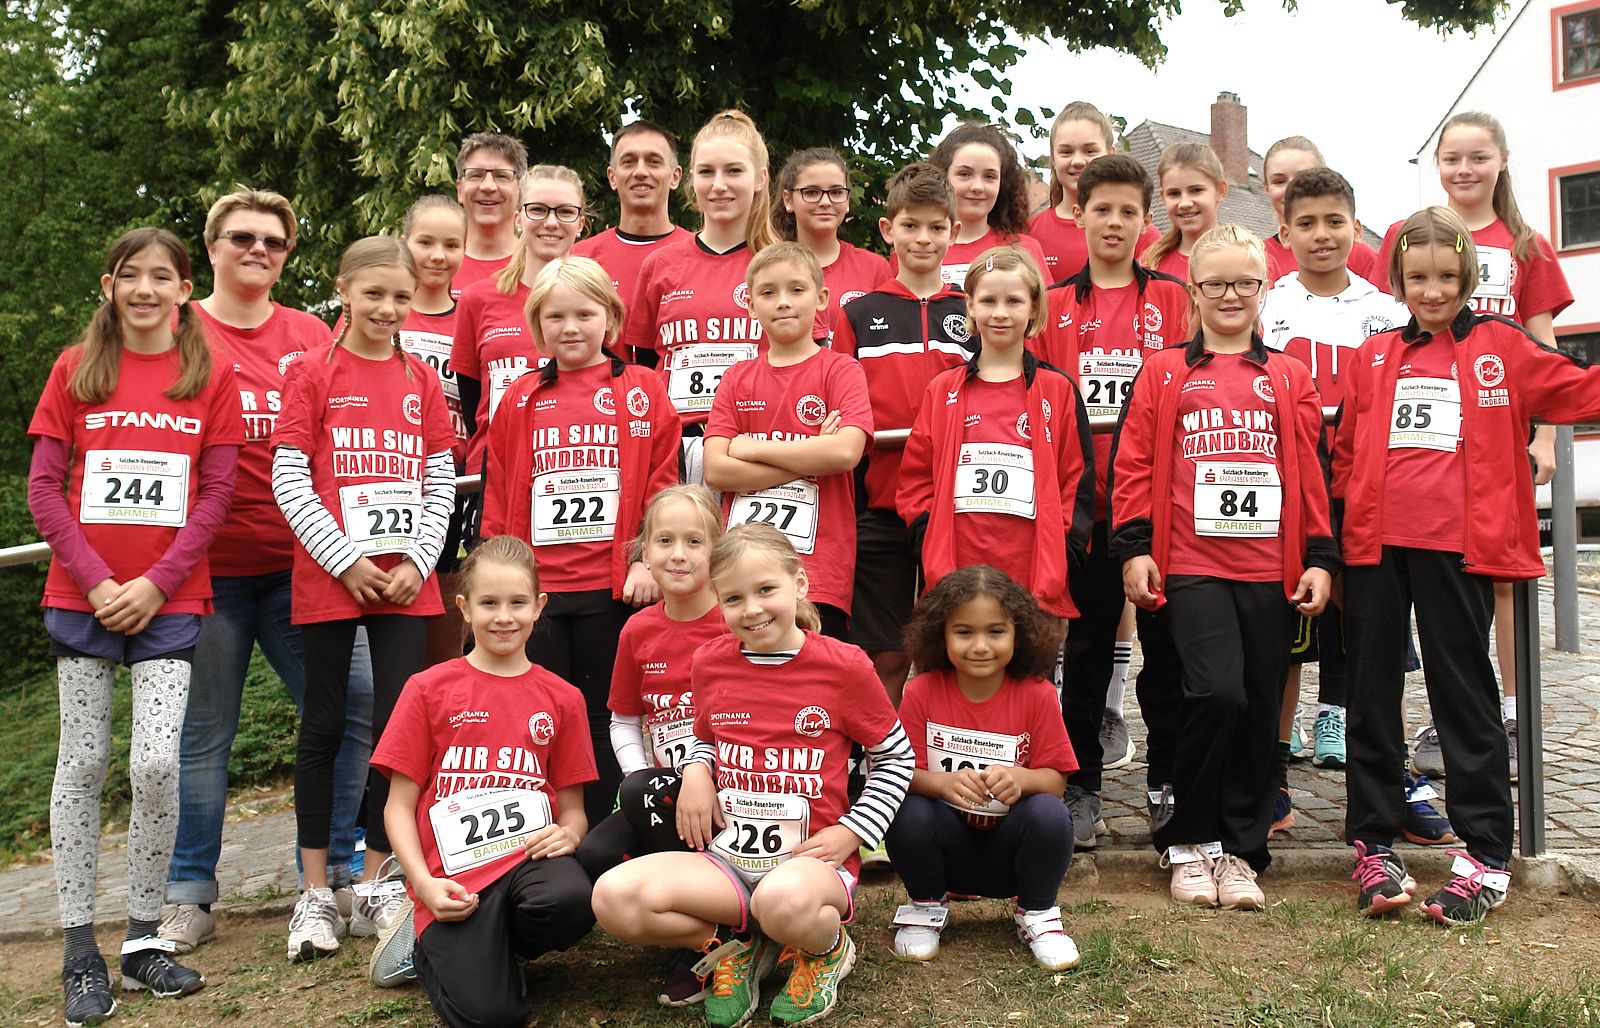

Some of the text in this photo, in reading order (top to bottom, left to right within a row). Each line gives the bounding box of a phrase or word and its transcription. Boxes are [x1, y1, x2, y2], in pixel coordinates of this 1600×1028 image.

[660, 318, 763, 345] WIR SIND
[1087, 380, 1132, 404] 219
[85, 411, 201, 434] STANNO
[1182, 408, 1224, 432] WIR
[1395, 404, 1431, 429] 85
[332, 427, 376, 449] WIR
[532, 424, 618, 450] IR SIND
[533, 448, 618, 475] ANDBALL
[104, 477, 163, 506] 244
[972, 469, 1009, 494] 30
[108, 509, 158, 518] BARMER
[552, 496, 605, 524] 222
[966, 498, 1012, 508] BARMER
[1220, 490, 1258, 517] 84
[367, 508, 412, 536] 223
[745, 501, 797, 530] 227
[1215, 521, 1262, 531] BARMER
[557, 527, 602, 537] BARMER
[710, 712, 751, 720] SPORTNANKA
[951, 735, 1004, 749] Sulzbach-Rosenberger
[718, 740, 825, 771] WIR SIND
[736, 798, 785, 809] Sulzbach-Rosenberger
[460, 801, 525, 846] 225
[473, 835, 528, 859] BARMER
[728, 820, 782, 854] 226
[729, 855, 779, 868] BARMER
